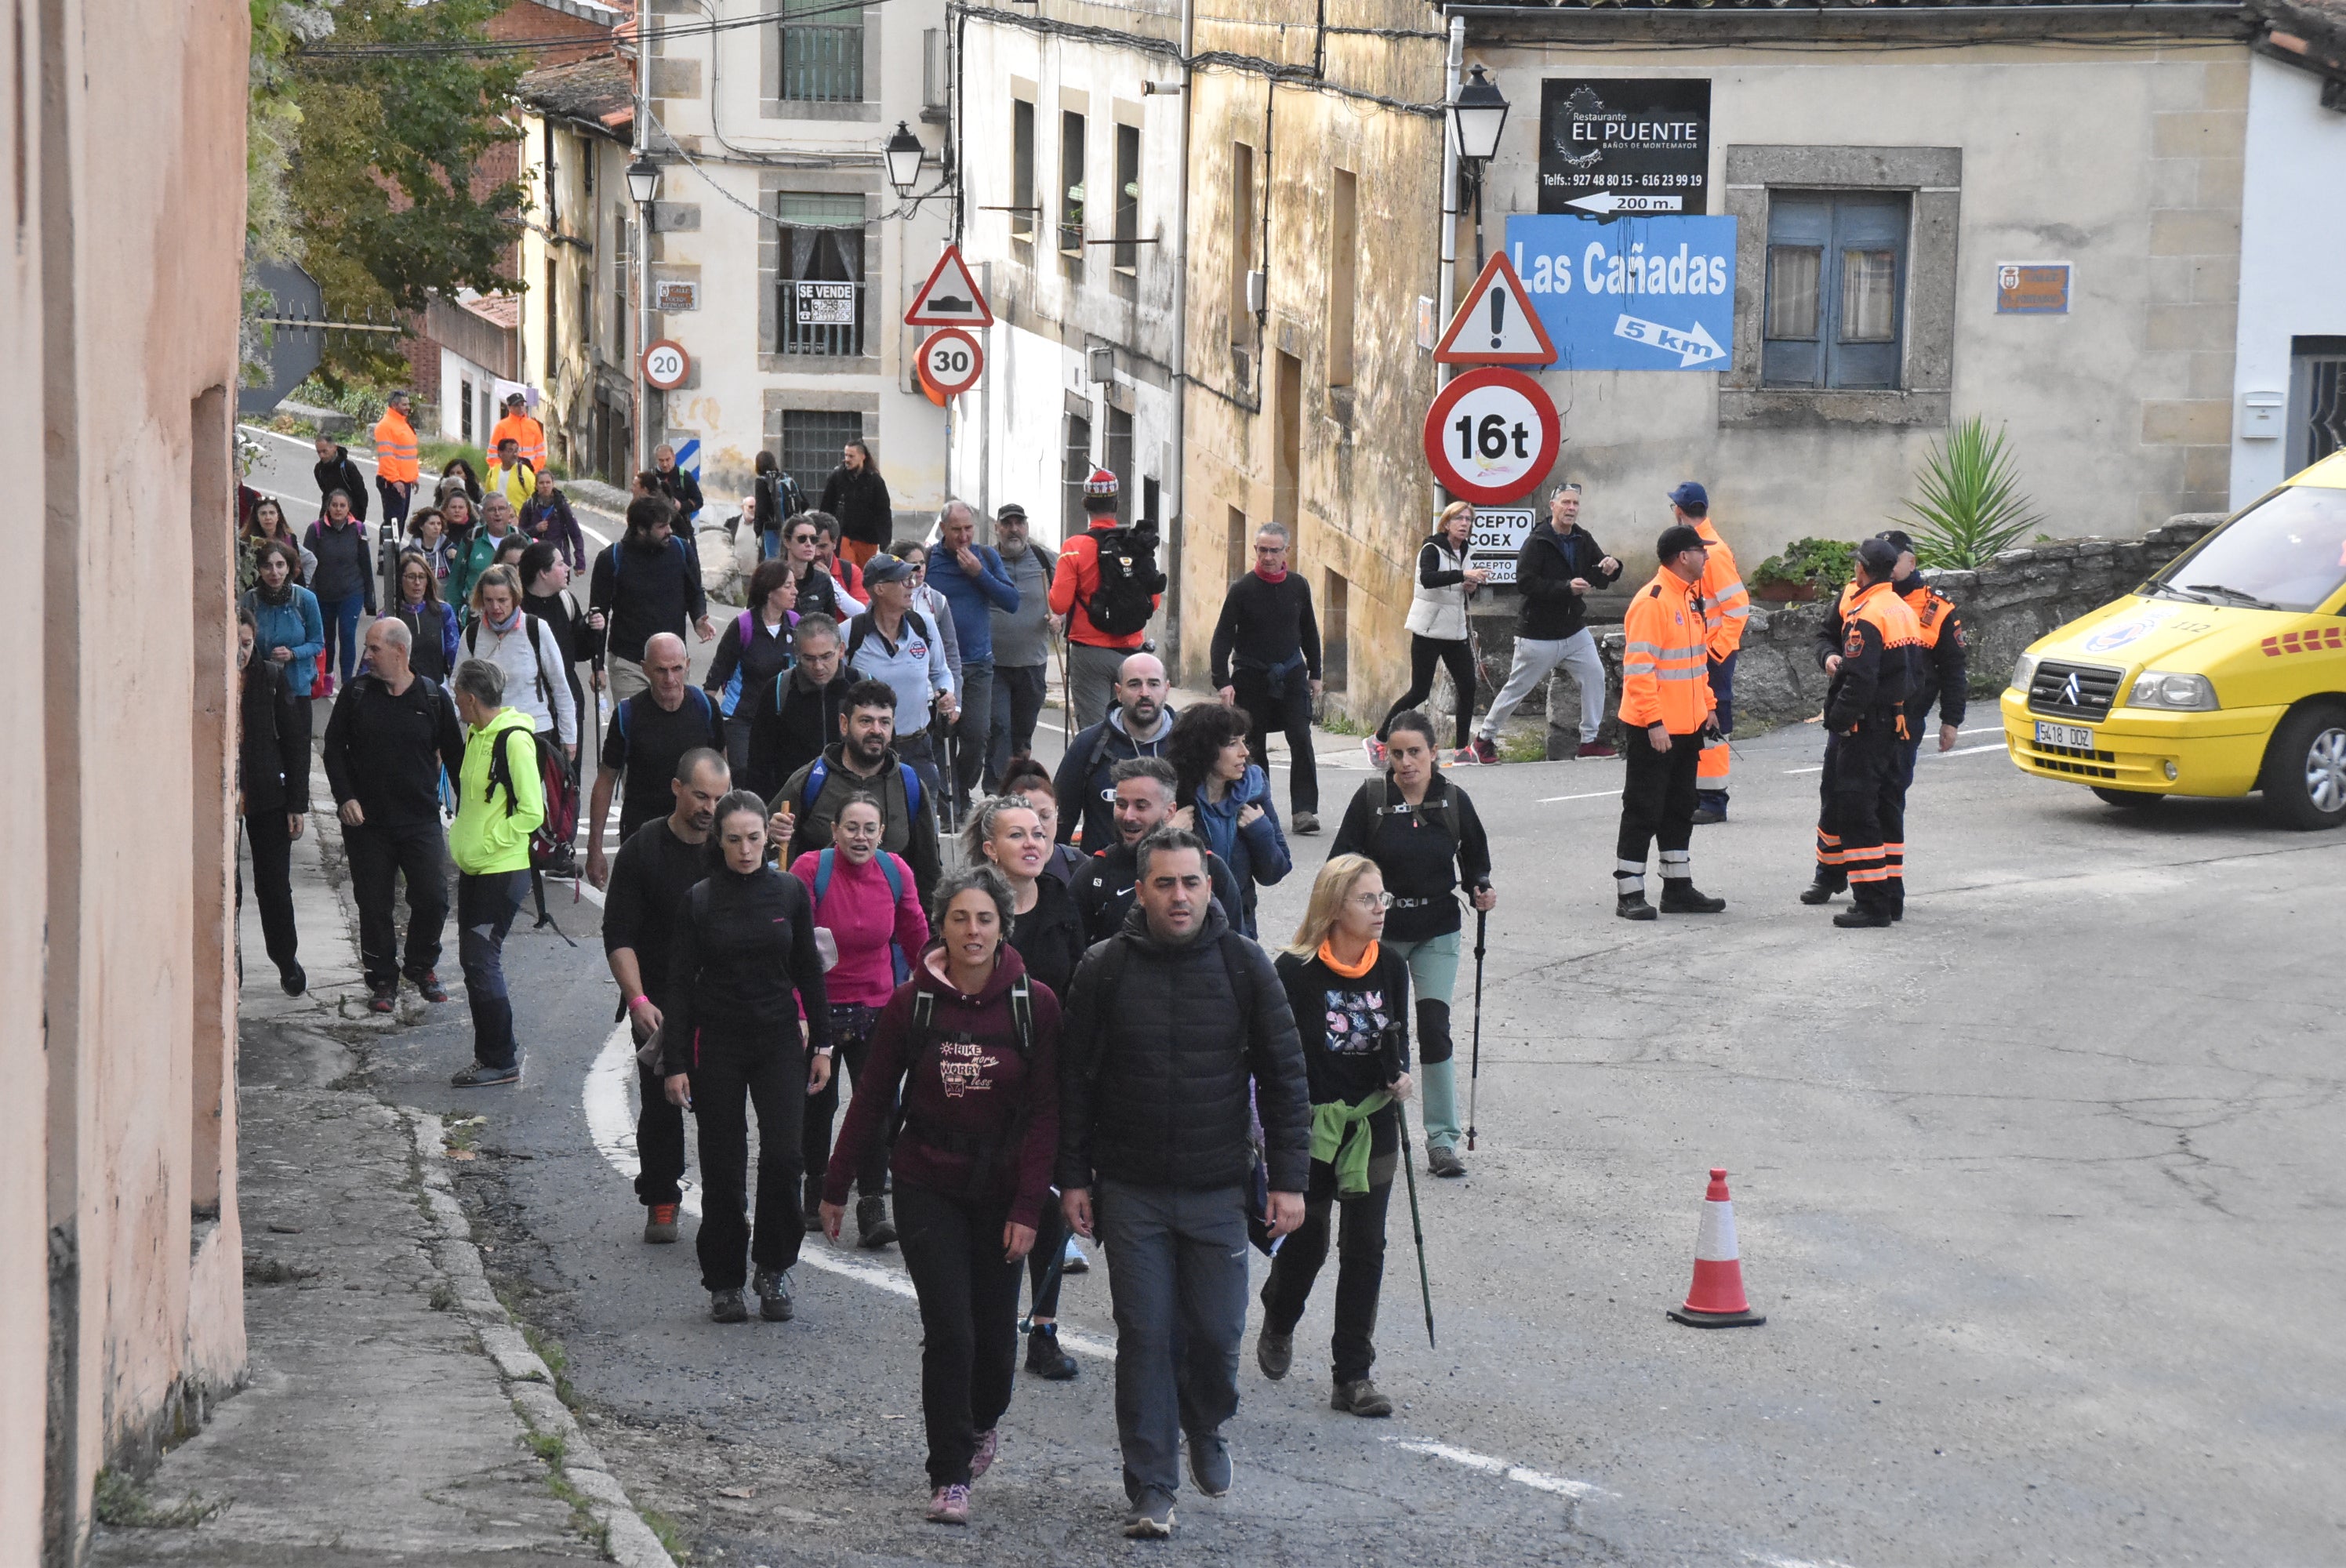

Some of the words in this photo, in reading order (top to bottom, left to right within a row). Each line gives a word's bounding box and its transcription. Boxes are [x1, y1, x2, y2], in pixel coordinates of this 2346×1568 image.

[1572, 122, 1598, 140] EL
[1605, 122, 1698, 140] PUENTE
[1543, 174, 1571, 186] Telfs.:
[1573, 174, 1591, 186] 927
[1592, 174, 1605, 186] 48
[1607, 174, 1619, 186] 80
[1621, 174, 1633, 186] 15
[1642, 174, 1660, 186] 616
[1661, 174, 1674, 186] 23
[1676, 174, 1688, 187] 99
[1690, 174, 1702, 187] 19
[1617, 198, 1648, 209] 200
[1653, 198, 1674, 209] m.
[1514, 241, 1571, 293] Las
[1583, 241, 1727, 295] Cañadas
[799, 285, 813, 298] SE
[815, 285, 852, 299] VENDE
[1623, 320, 1646, 339] 5
[1658, 329, 1714, 359] km
[653, 356, 677, 373] 20
[933, 350, 968, 372] 30
[1455, 414, 1529, 459] 16t
[1473, 515, 1528, 528] CEPTO
[1468, 533, 1512, 546] COEX
[1472, 561, 1512, 570] XCEPTO
[2170, 621, 2211, 633] 112
[2040, 724, 2063, 742] 5418
[2070, 728, 2089, 747] DDZ
[955, 1044, 982, 1055] HIKE
[971, 1055, 997, 1065] more
[941, 1063, 980, 1075] WORRY
[971, 1075, 993, 1087] less
